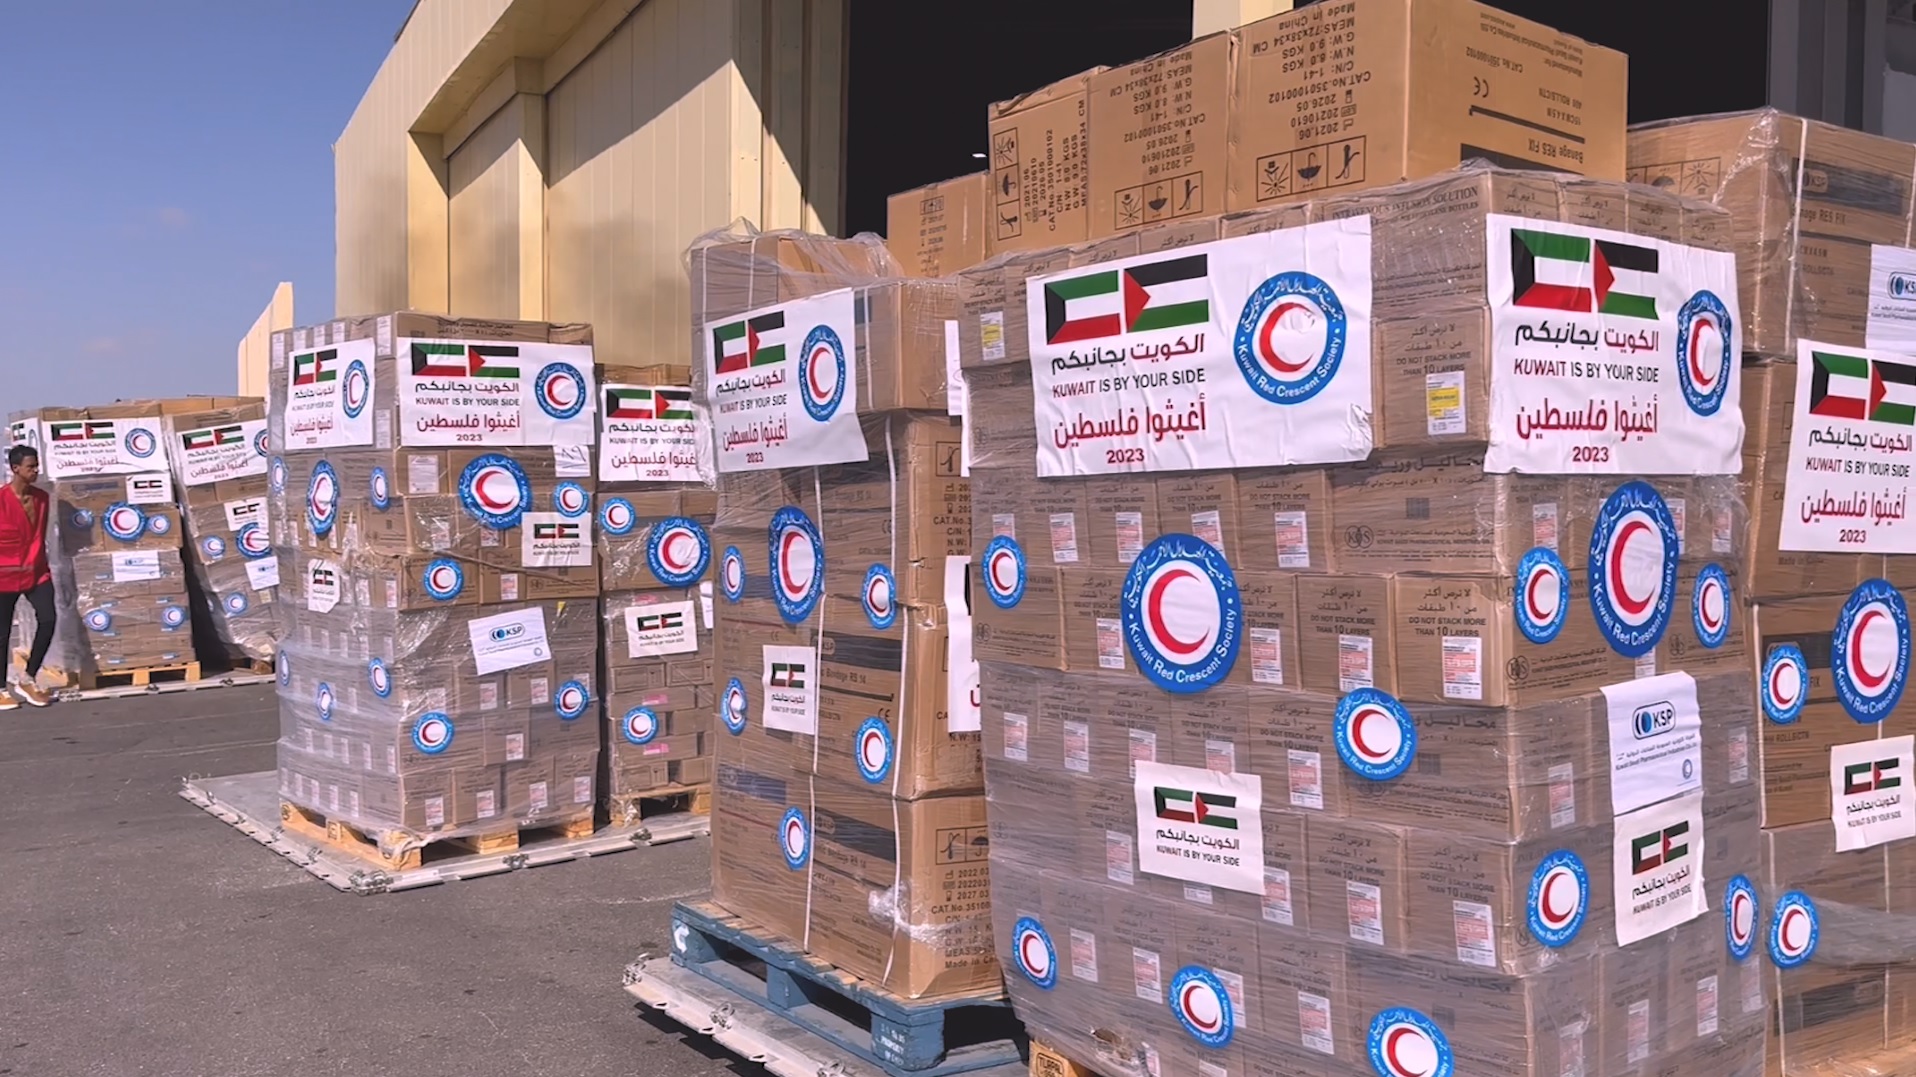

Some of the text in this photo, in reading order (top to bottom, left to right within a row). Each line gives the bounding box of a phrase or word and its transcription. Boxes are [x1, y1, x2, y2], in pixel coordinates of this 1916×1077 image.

[1279, 2, 1355, 30] Made in China
[1253, 40, 1267, 54] CM
[1282, 31, 1354, 59] G.W: 9.0 KGS
[1130, 51, 1191, 76] Made in China
[1282, 46, 1354, 73] N.W: 8.0 KGS
[1303, 61, 1353, 80] C/N: 1-41
[1110, 85, 1121, 96] CM
[1133, 89, 1151, 101] KGS
[1154, 84, 1167, 95] 9.0
[1079, 100, 1085, 116] CM
[1133, 102, 1151, 115] KGS
[1296, 94, 1336, 112] 2026.05
[1150, 111, 1168, 122] 1-41
[1290, 108, 1339, 127] 20210610
[1299, 122, 1339, 140] 2021.06
[1146, 134, 1178, 150] 2026.05
[1528, 139, 1539, 153] FIX
[1542, 143, 1556, 157] RES
[1141, 146, 1180, 163] 20210610
[1148, 159, 1181, 175] 2021.06
[1433, 186, 1478, 204] SOLUTION
[1515, 321, 1659, 354] الكويت بجانبكم
[1052, 333, 1204, 375] الكويت بجانبكم
[1238, 337, 1341, 397] Kuwait Red Crescent Society
[1514, 359, 1659, 382] KUWAIT IS BY YOUR SIDE
[415, 381, 519, 394] الكويت بجانبكم
[716, 369, 785, 397] الكويت بجانبكم
[1053, 369, 1205, 398] KUWAIT IS BY YOUR SIDE
[720, 394, 787, 413] KUWAIT IS BY YOUR SIDE
[417, 411, 520, 432] أغيثوا فلسطين
[1054, 393, 1206, 448] أغيثوا فلسطين
[1517, 394, 1658, 441] أغيثوا فلسطين
[609, 423, 657, 433] بجانبكم
[723, 412, 788, 451] أغيثوا فلسطين
[1809, 426, 1912, 453] الكويت بجانبكم
[611, 451, 666, 468] فلسطين
[746, 452, 764, 463] 2023
[1107, 448, 1145, 463] 2023
[1573, 446, 1609, 462] 2023
[1806, 457, 1910, 477] KUWAIT IS BY YOUR SIDE
[1801, 487, 1906, 526] أغيثوا فلسطين
[1839, 530, 1866, 543] 2023
[1593, 561, 1675, 645] Kuwait Red Crescent Society
[506, 627, 522, 636] KSP
[1415, 627, 1479, 637] THAN 10 LAYERS
[1129, 622, 1153, 664] Kuwait
[1153, 659, 1173, 680] Red
[1175, 657, 1221, 682] Crescent
[1216, 609, 1237, 657] Society
[1653, 709, 1673, 728] KSP
[1156, 829, 1239, 849] الكويت بجانبكم
[1157, 845, 1240, 866] KUWAIT IS BY YOUR SIDE
